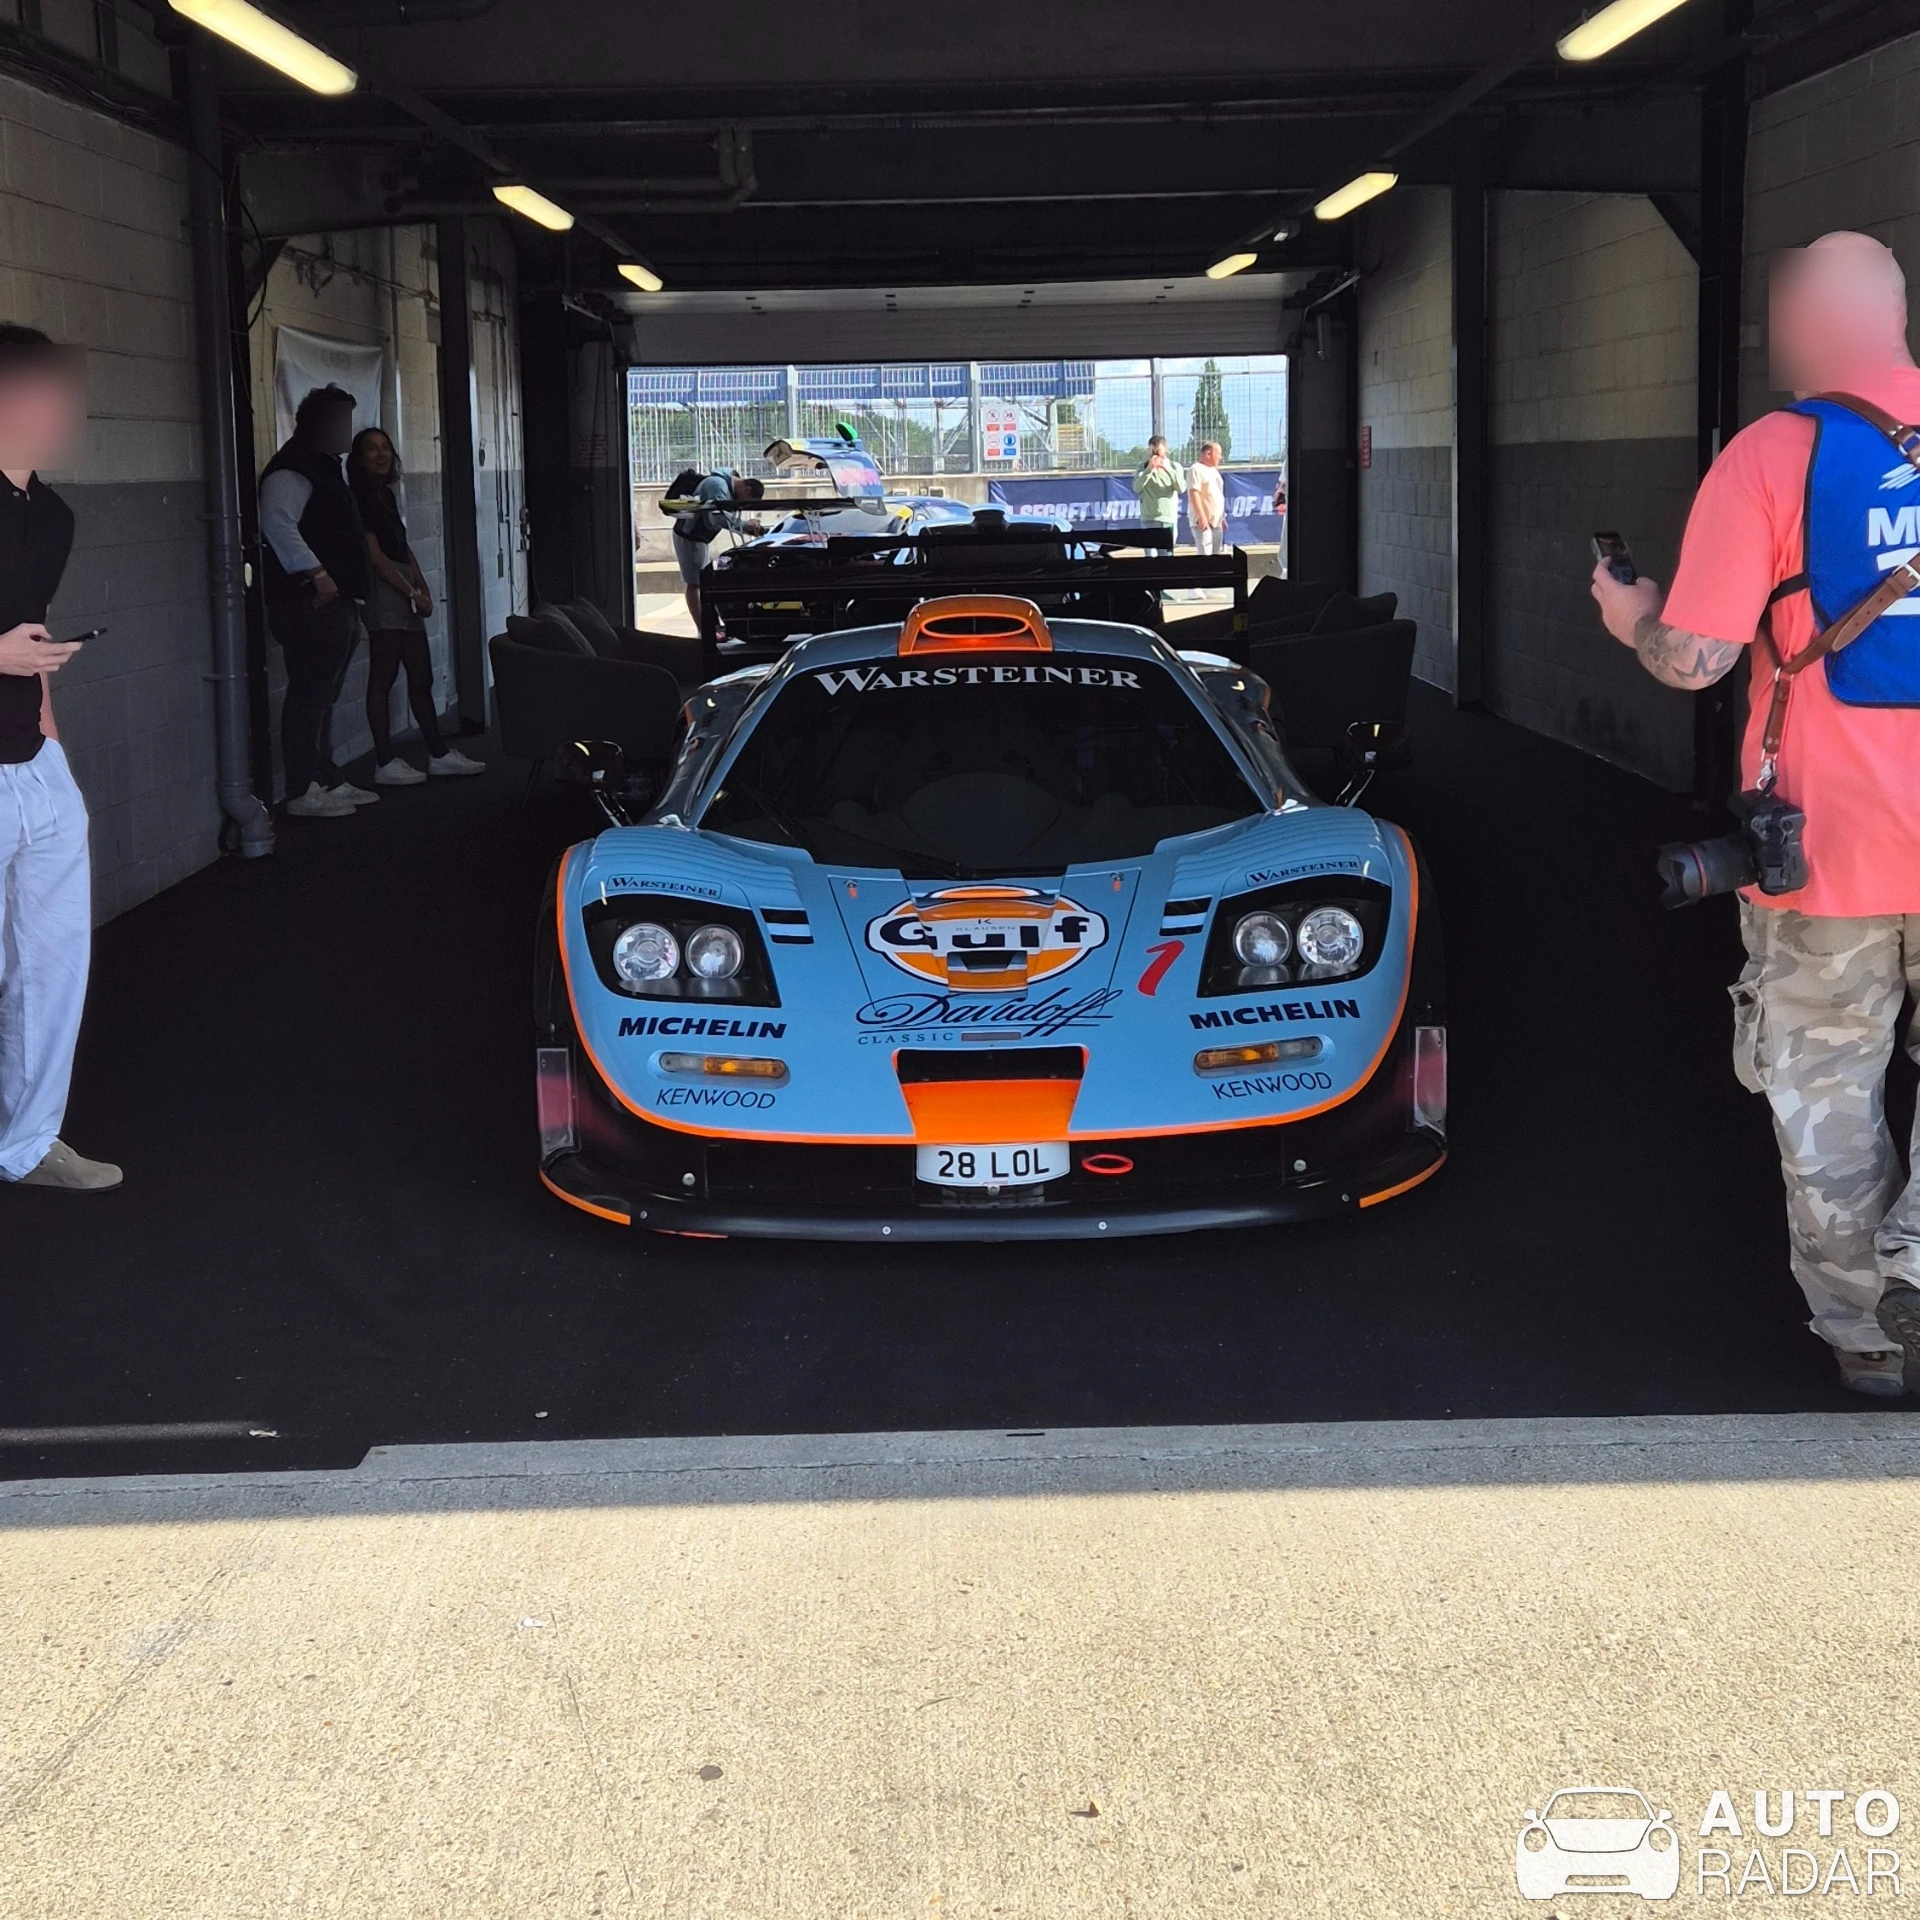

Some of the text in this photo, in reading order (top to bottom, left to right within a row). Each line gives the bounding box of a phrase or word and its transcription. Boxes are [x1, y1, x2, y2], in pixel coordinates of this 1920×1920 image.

[1019, 502, 1091, 522] SECRET
[1095, 499, 1141, 520] WITH
[1232, 496, 1258, 518] OF
[1868, 505, 1920, 546] M
[813, 666, 1143, 696] WARSTEINER
[1249, 860, 1359, 883] WARSTEINER
[612, 877, 718, 897] WARSTEINER
[879, 915, 1090, 949] Gulf
[1137, 938, 1185, 997] 1
[855, 987, 1124, 1037] Davidoff
[1189, 1000, 1361, 1030] MICHELIN
[618, 1017, 788, 1039] MICHELIN
[858, 1032, 954, 1045] CLASSIC
[656, 1088, 776, 1110] KENWOOD
[1212, 1072, 1332, 1100] KENWOOD
[938, 1148, 1050, 1179] 28 LOL
